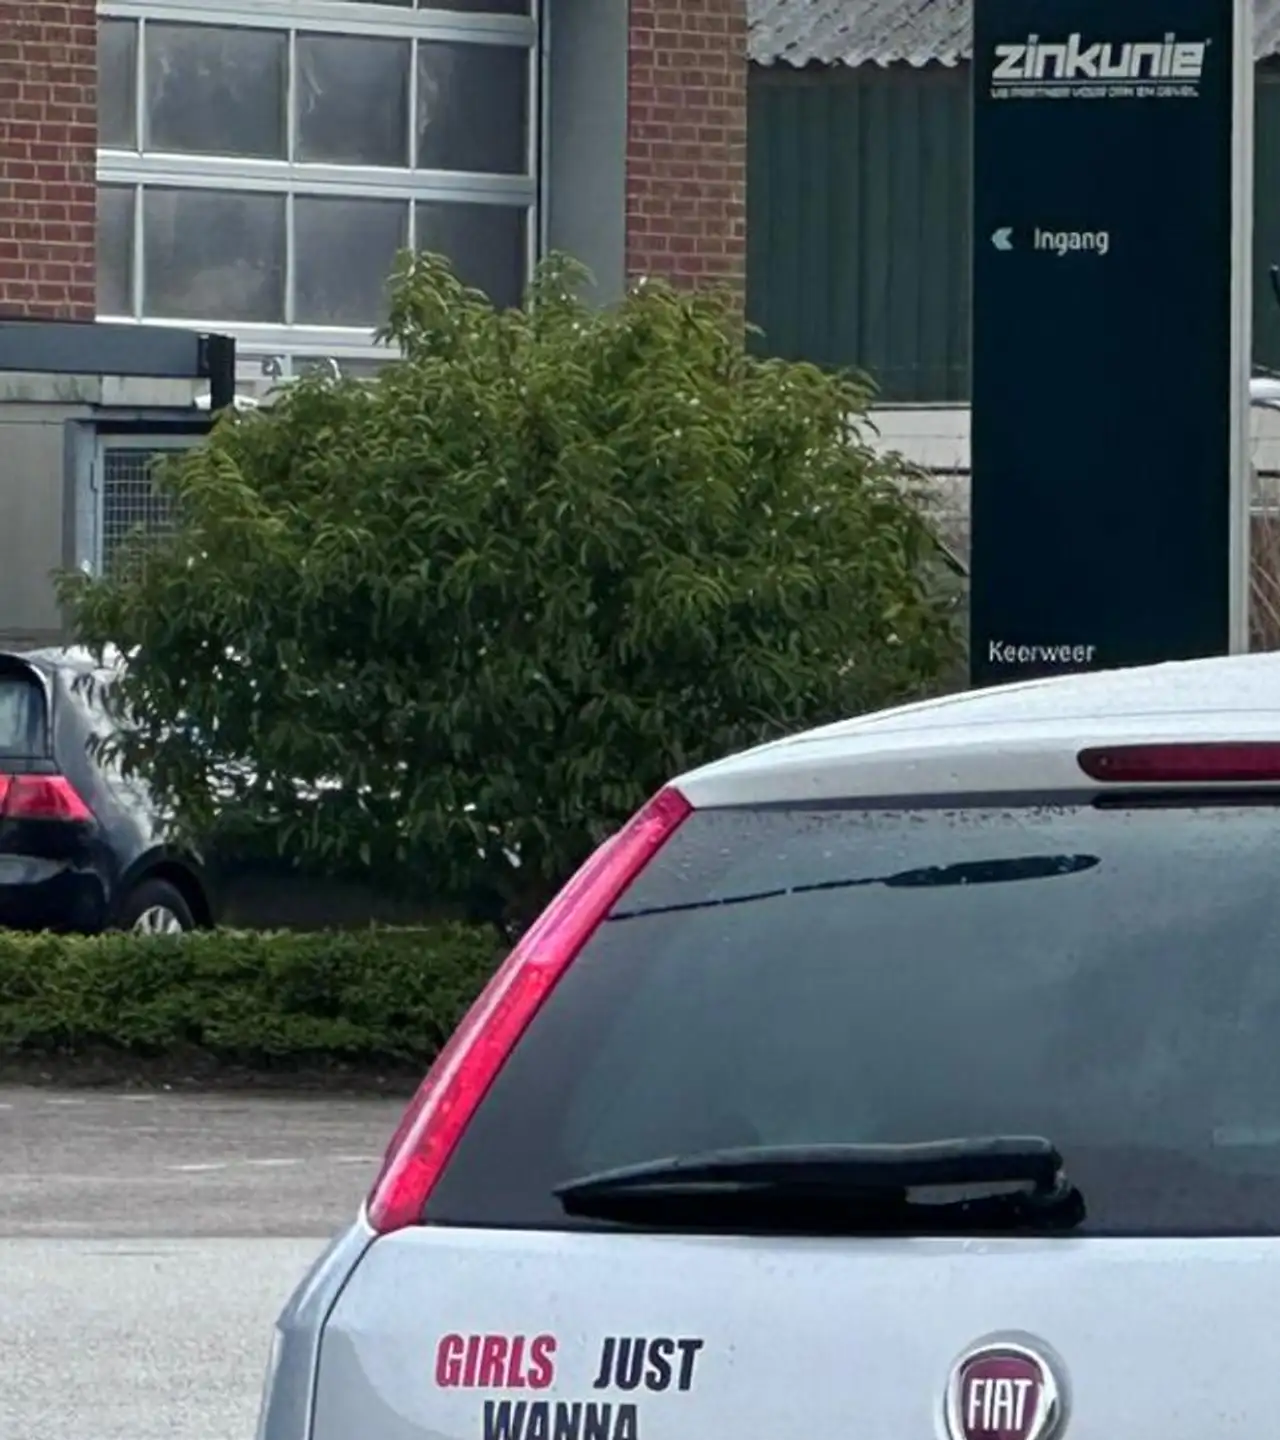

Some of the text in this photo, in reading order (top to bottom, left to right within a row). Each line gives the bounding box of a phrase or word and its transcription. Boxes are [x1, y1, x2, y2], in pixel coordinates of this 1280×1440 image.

[992, 32, 1205, 79] zinkunie
[1034, 227, 1109, 256] Ingang
[435, 1334, 704, 1392] GIRLS JUST
[968, 1378, 1034, 1431] FIAT
